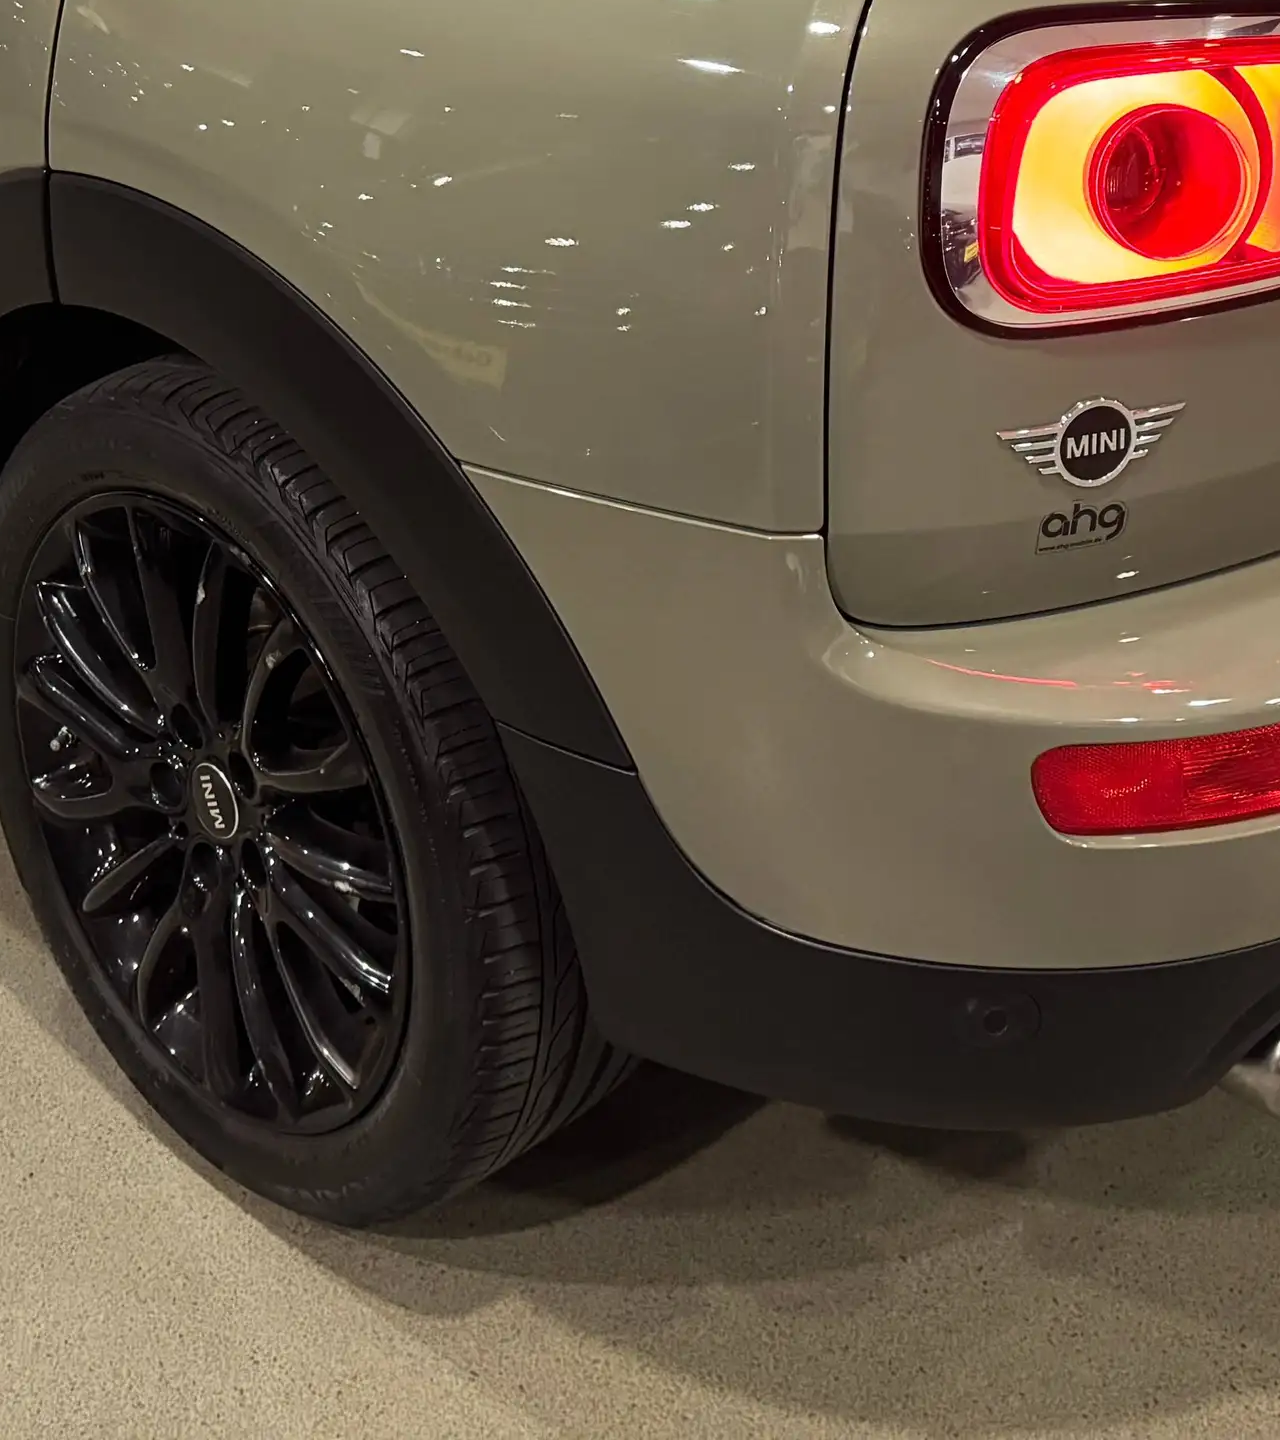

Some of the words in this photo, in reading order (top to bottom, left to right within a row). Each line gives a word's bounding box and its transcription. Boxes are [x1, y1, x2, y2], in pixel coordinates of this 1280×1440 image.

[1066, 427, 1126, 460] MINI
[1041, 503, 1126, 541] ahg
[199, 774, 226, 829] MINI
